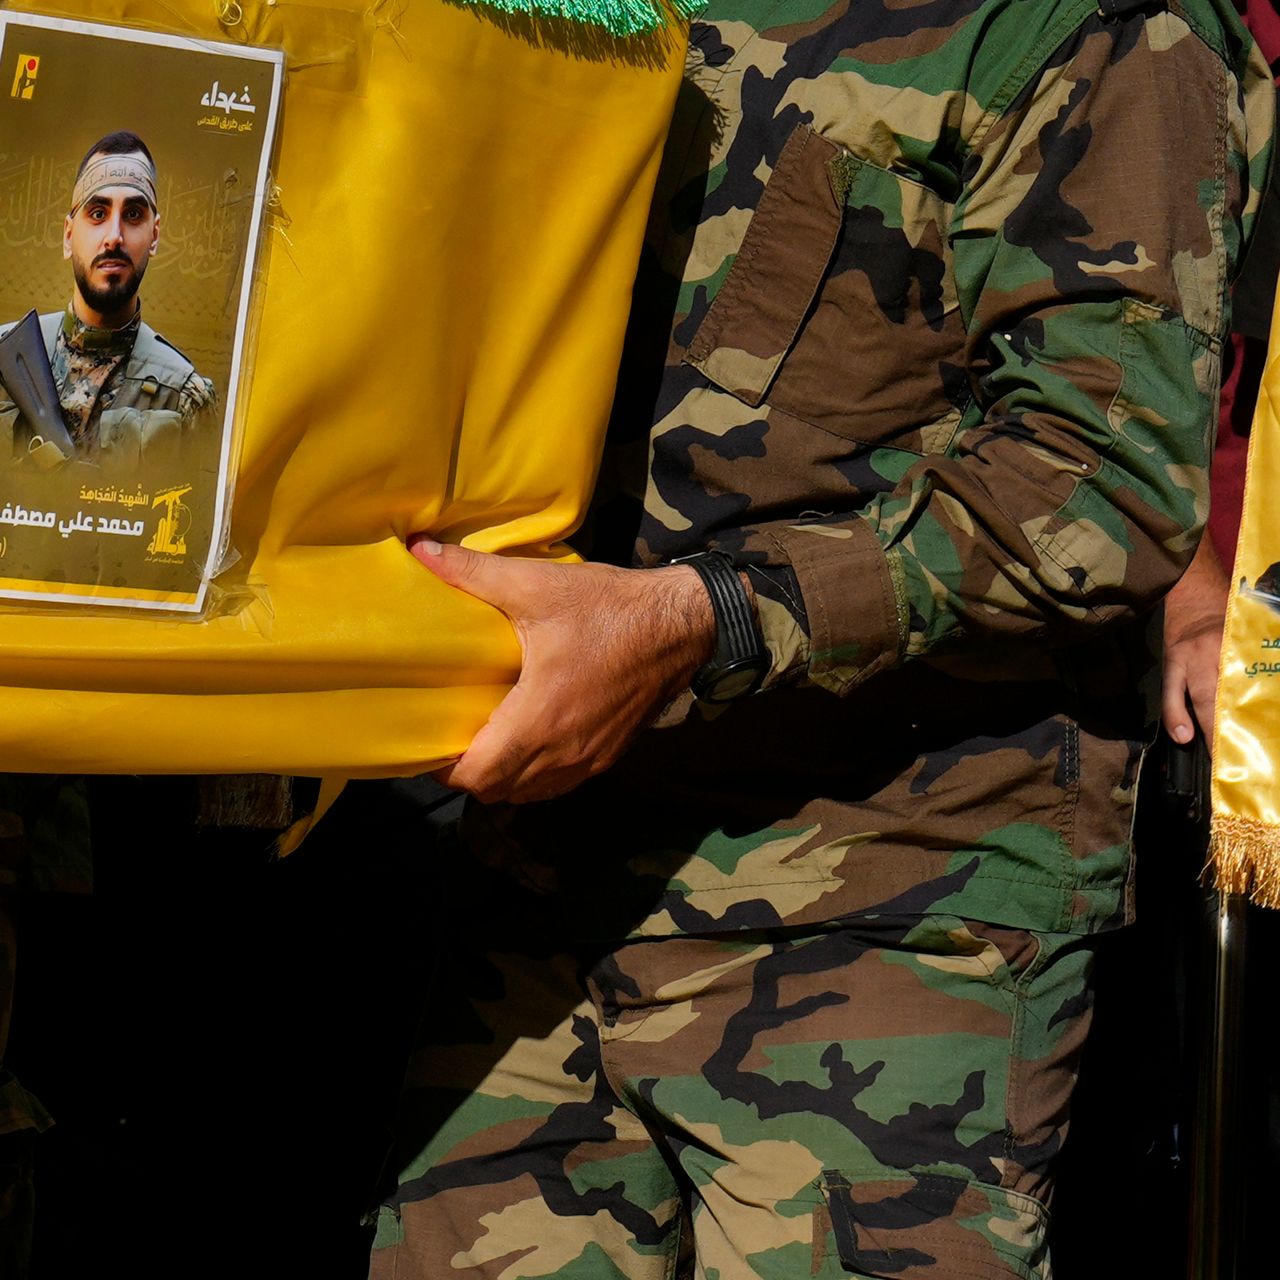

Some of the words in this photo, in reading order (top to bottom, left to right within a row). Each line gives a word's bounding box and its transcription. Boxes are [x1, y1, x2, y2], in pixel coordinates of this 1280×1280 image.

[200, 80, 256, 115] شهداء
[196, 115, 219, 126] القدس
[220, 117, 238, 130] طريق
[58, 511, 93, 539] علي
[96, 517, 144, 536] محمد
